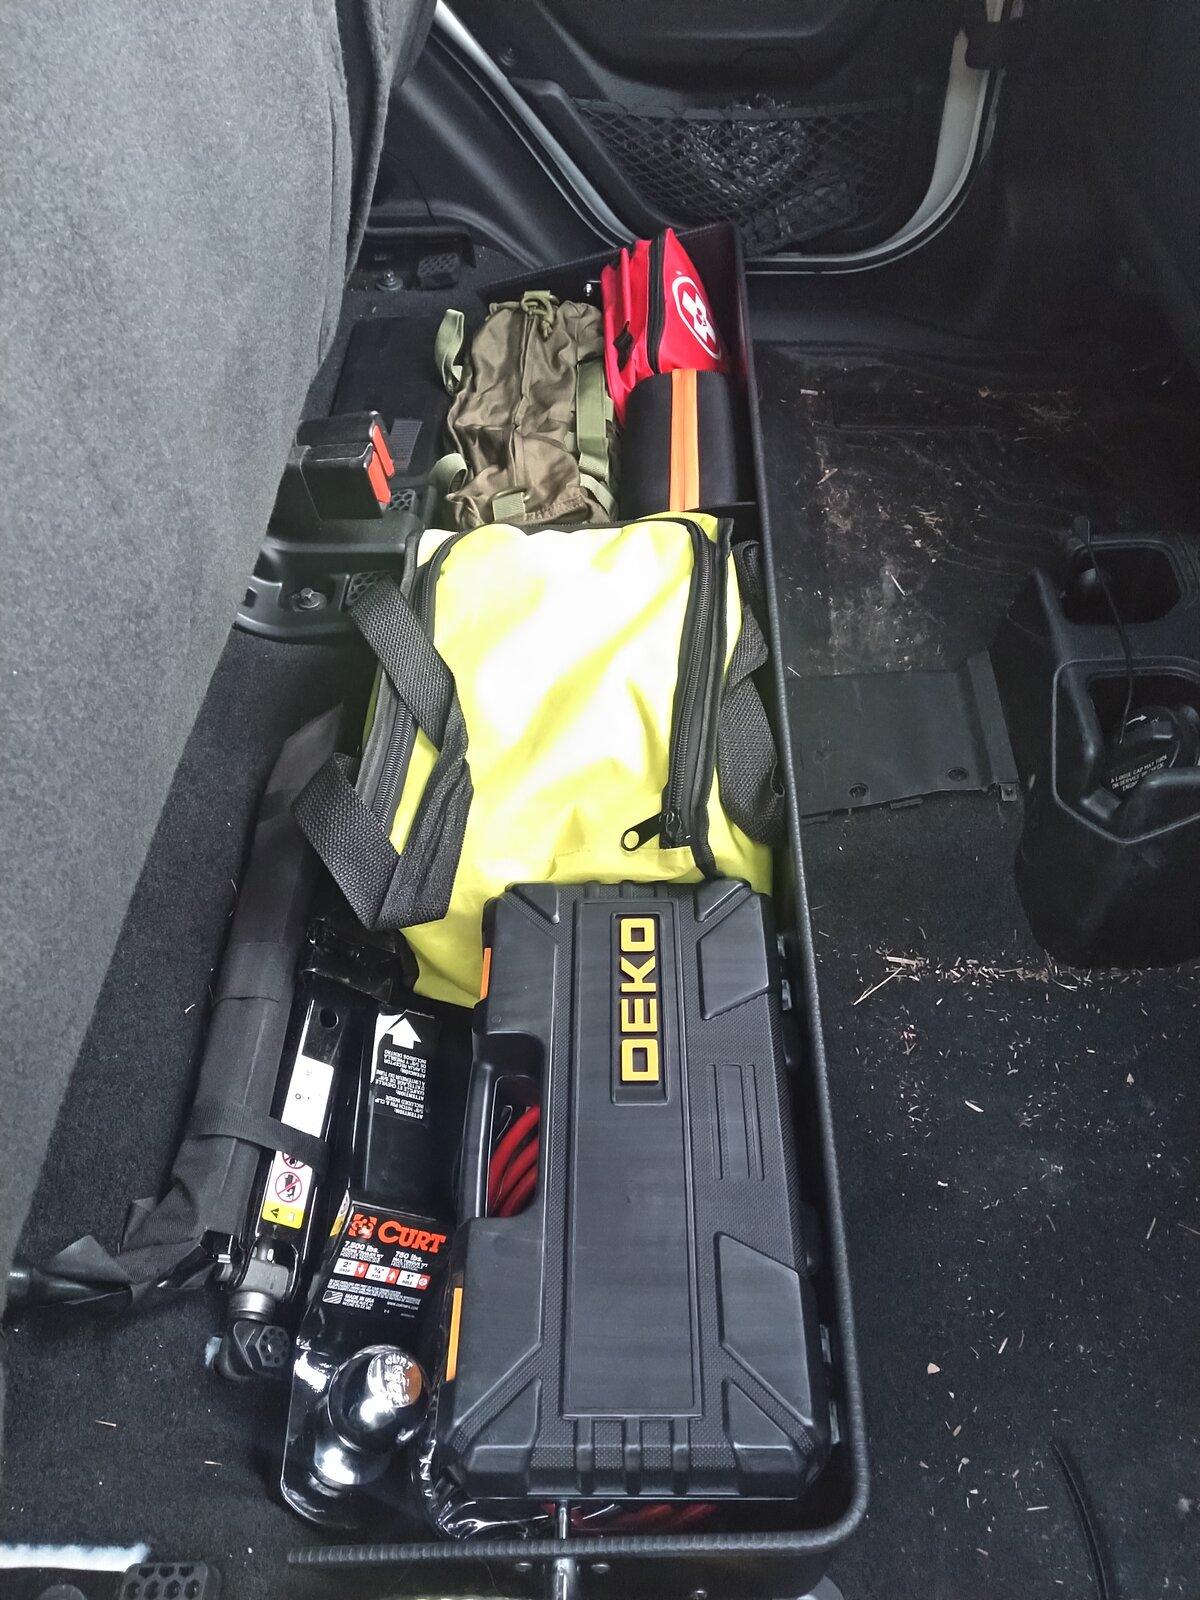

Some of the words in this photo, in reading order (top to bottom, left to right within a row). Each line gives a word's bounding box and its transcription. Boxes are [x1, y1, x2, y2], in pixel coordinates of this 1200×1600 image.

[1133, 767, 1143, 775] CAP
[620, 918, 659, 1081] DEKO
[394, 1108, 423, 1119] ATTENTION:
[378, 1220, 447, 1253] CURT
[344, 1240, 365, 1251] 7,500
[366, 1244, 379, 1254] lbs.
[395, 1250, 410, 1260] 750
[410, 1253, 423, 1262] lbs.
[345, 1293, 359, 1301] MADE
